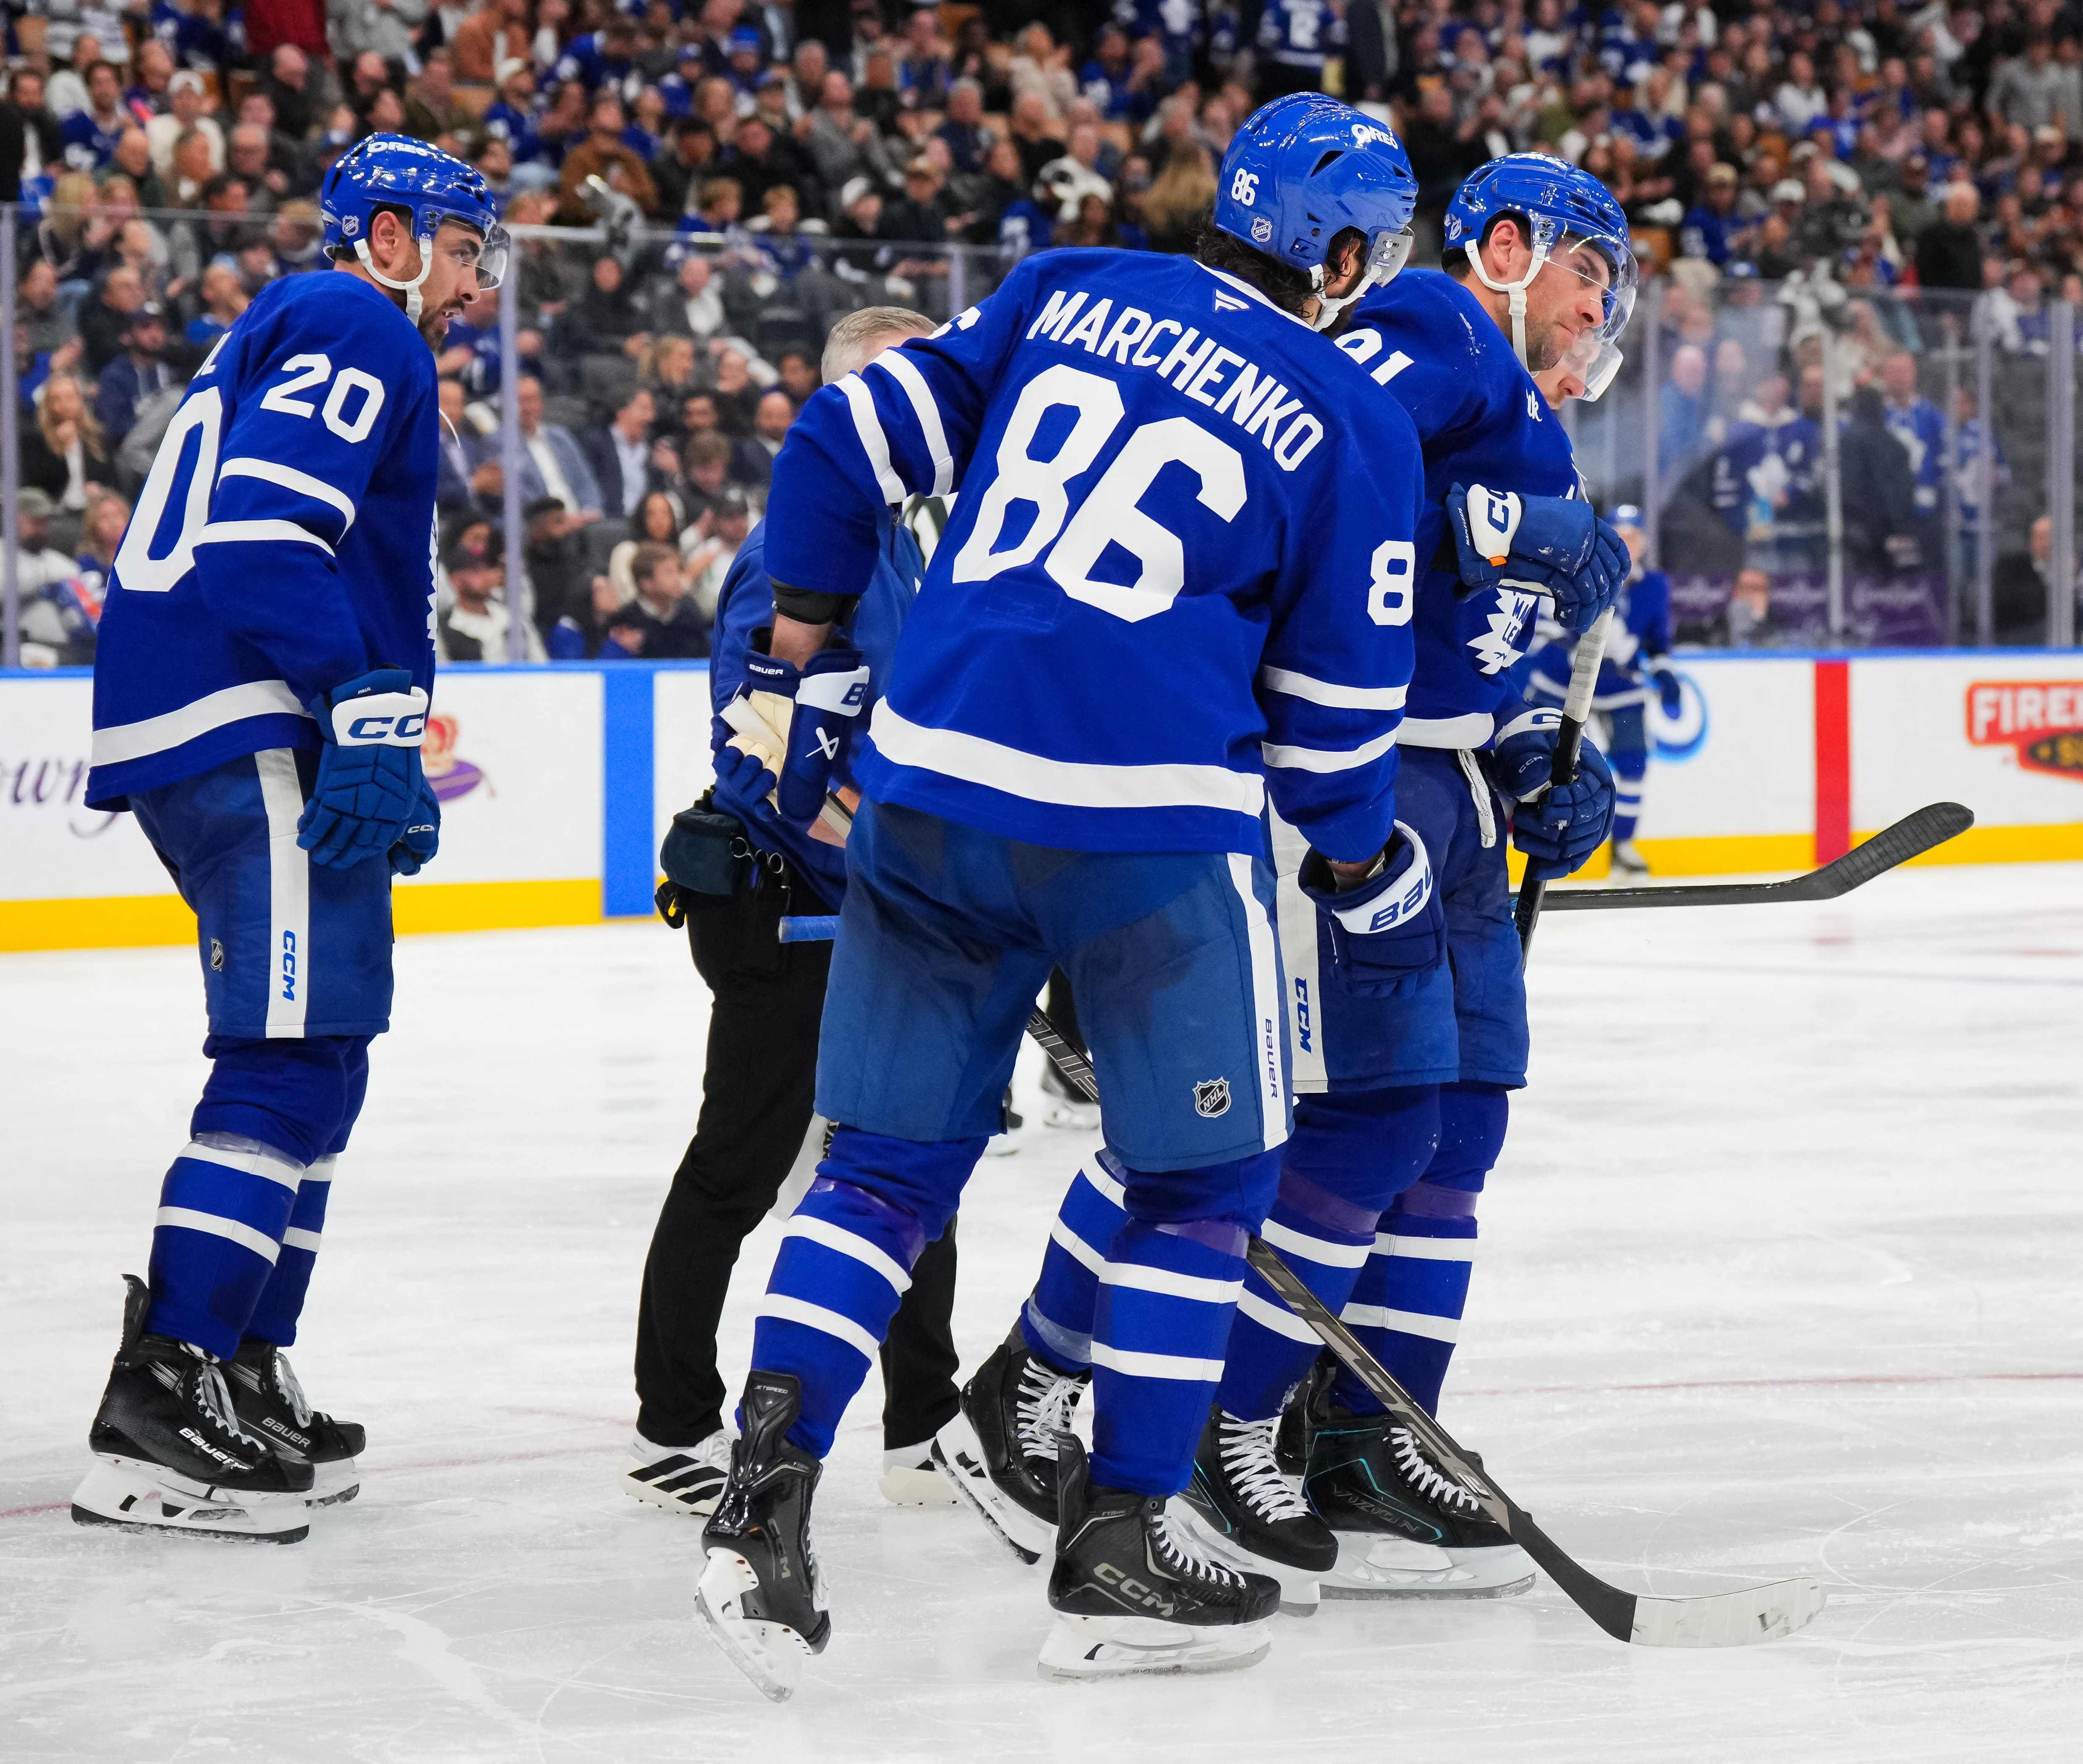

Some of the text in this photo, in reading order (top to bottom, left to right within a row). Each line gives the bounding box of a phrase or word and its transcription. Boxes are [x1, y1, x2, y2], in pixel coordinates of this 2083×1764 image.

[367, 141, 428, 157] OREO
[1351, 124, 1399, 150] OREO
[1231, 168, 1259, 207] 86
[259, 353, 385, 443] 20
[1026, 290, 1324, 472] MARCHENKO
[105, 386, 223, 592] 0
[952, 364, 1248, 623] 86
[1367, 540, 1416, 626] 8
[749, 664, 783, 675] BAUER
[347, 712, 425, 739] CC
[1974, 688, 2083, 741] FIRE
[1519, 756, 1543, 774] CCM
[283, 930, 296, 1002] CCM
[1295, 977, 1312, 1054] CCM
[1265, 1018, 1278, 1098] BAUER
[754, 1385, 788, 1394] JETSPEED
[262, 1417, 311, 1448] BAUER
[767, 1518, 791, 1579] CCM
[1094, 1563, 1174, 1617] CCM
